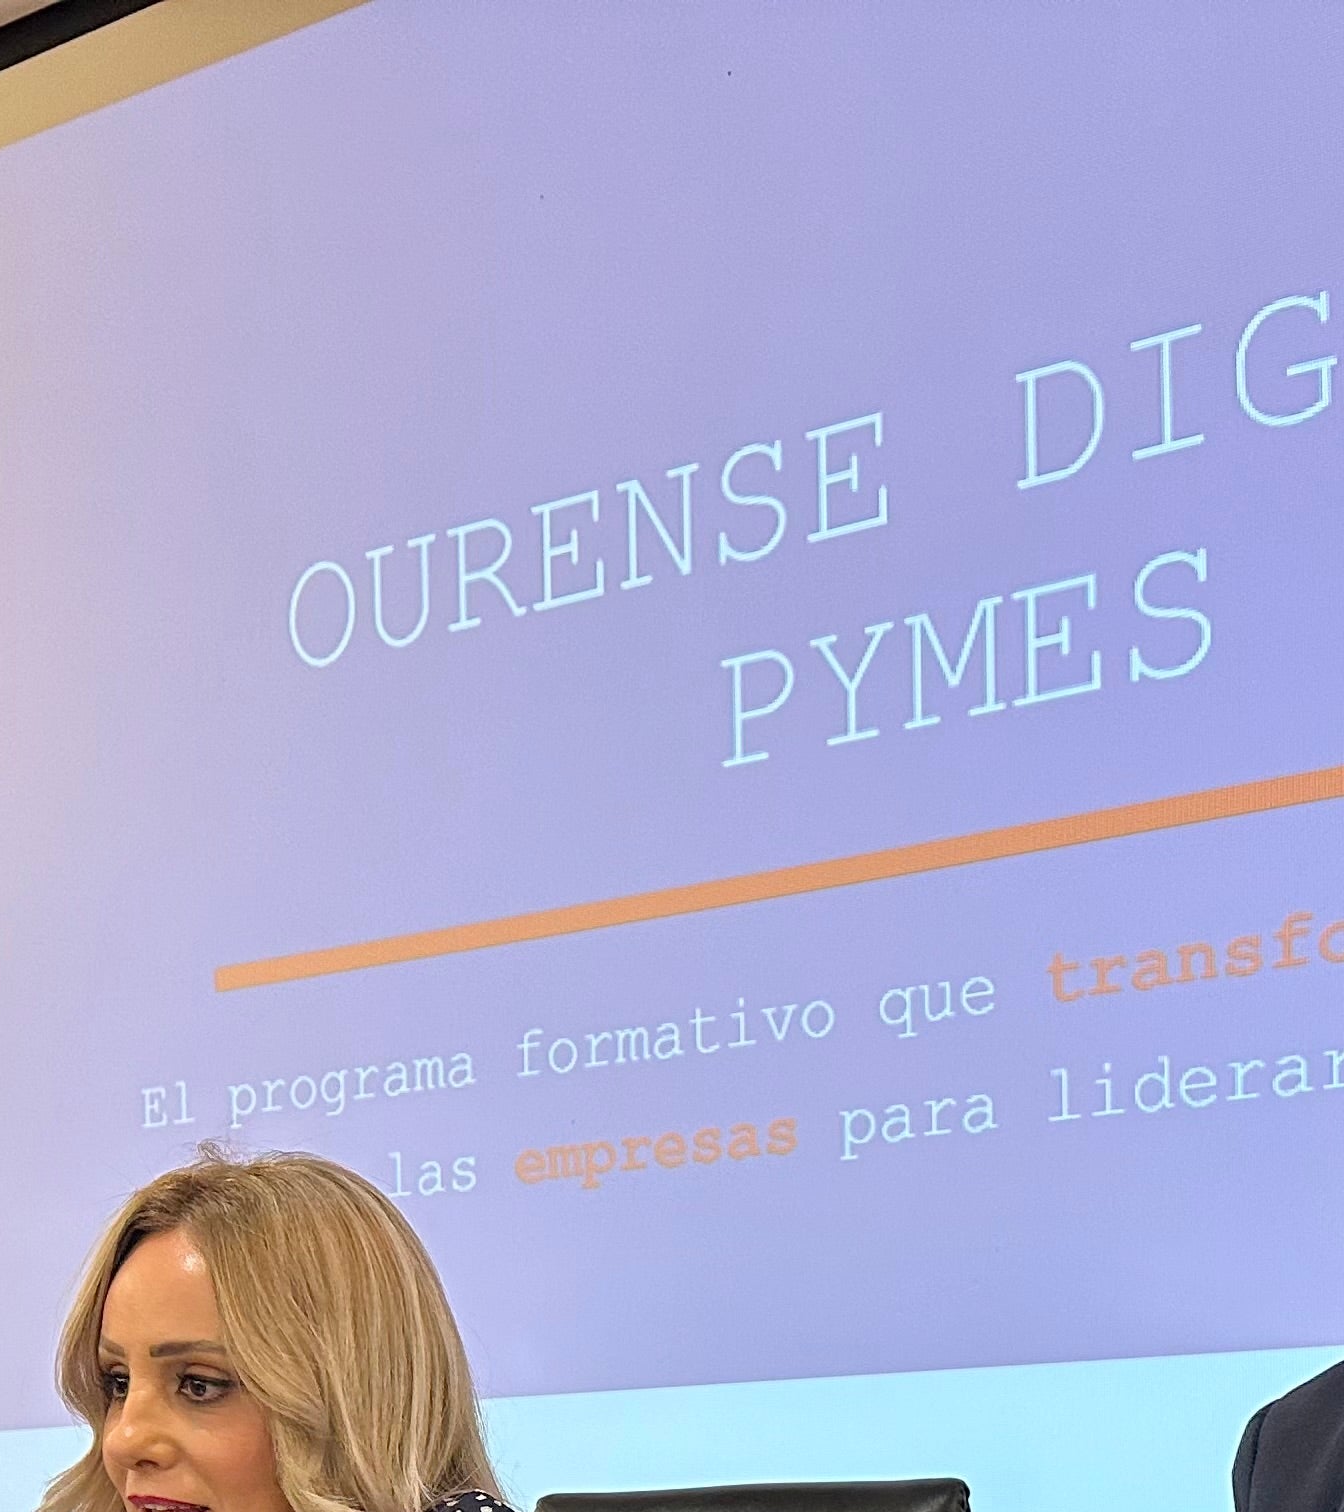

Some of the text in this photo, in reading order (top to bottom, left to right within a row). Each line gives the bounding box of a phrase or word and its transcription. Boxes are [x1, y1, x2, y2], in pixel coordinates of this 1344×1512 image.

[288, 411, 889, 668] OURENSE
[720, 547, 1213, 768] PYMES
[141, 1080, 196, 1130] El
[227, 1050, 477, 1130] programa
[516, 996, 836, 1078] formativo
[878, 971, 997, 1041] que
[387, 1151, 478, 1200] las
[514, 1116, 799, 1191] empresas
[838, 1090, 999, 1161] para
